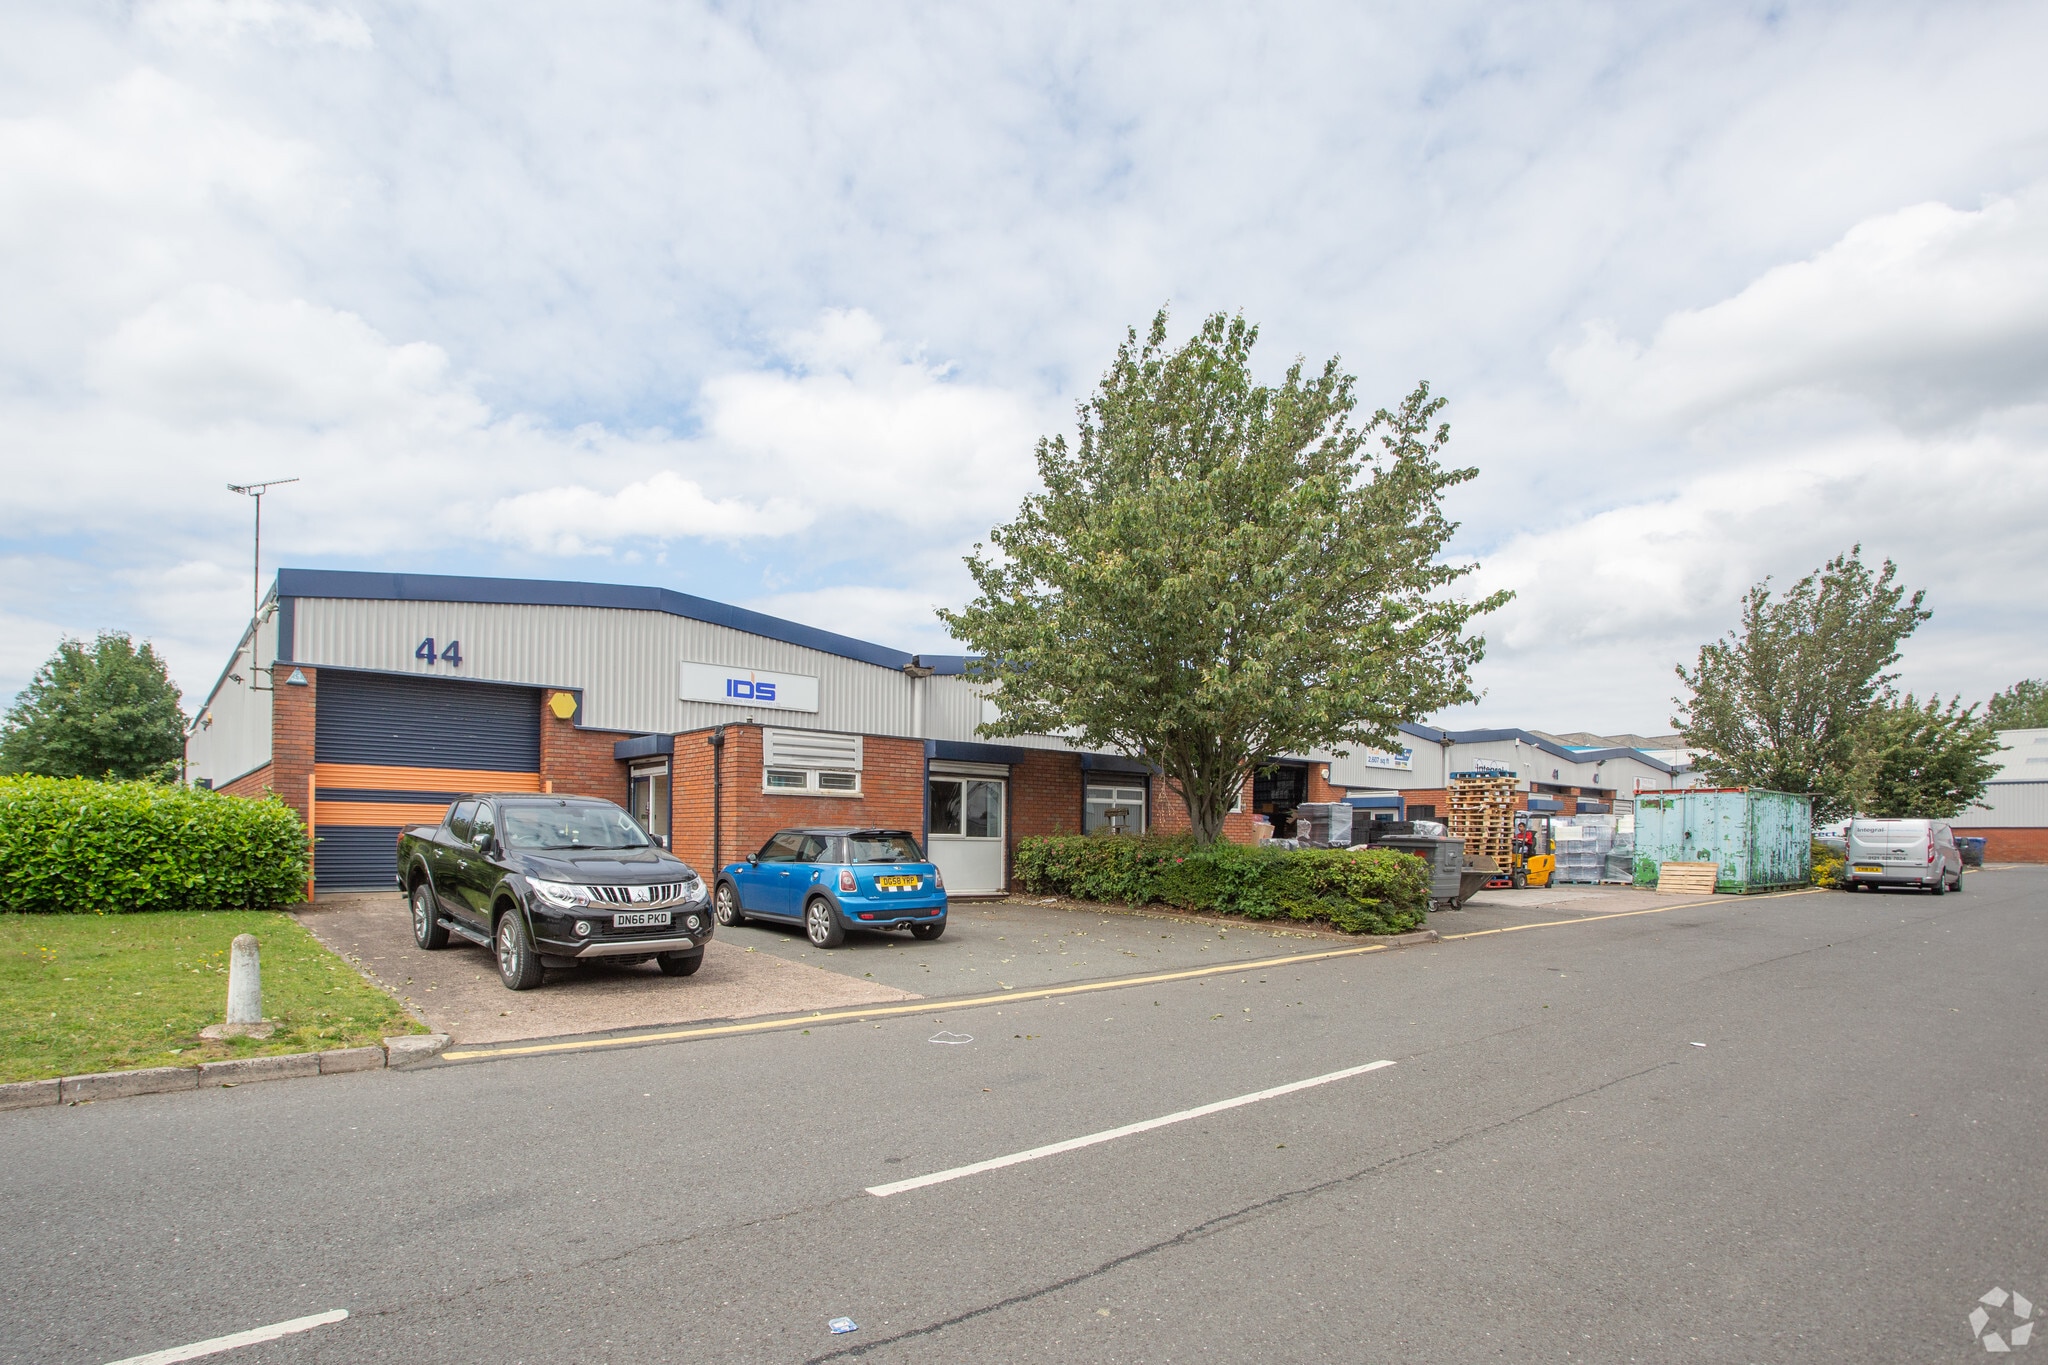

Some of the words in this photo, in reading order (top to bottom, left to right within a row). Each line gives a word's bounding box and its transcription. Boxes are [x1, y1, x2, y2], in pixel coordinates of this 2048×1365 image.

[415, 637, 463, 668] 44
[726, 678, 776, 701] IDS
[883, 877, 902, 886] DG58
[901, 876, 915, 885] YRP
[618, 914, 645, 925] DN66
[647, 913, 667, 924] PKD
